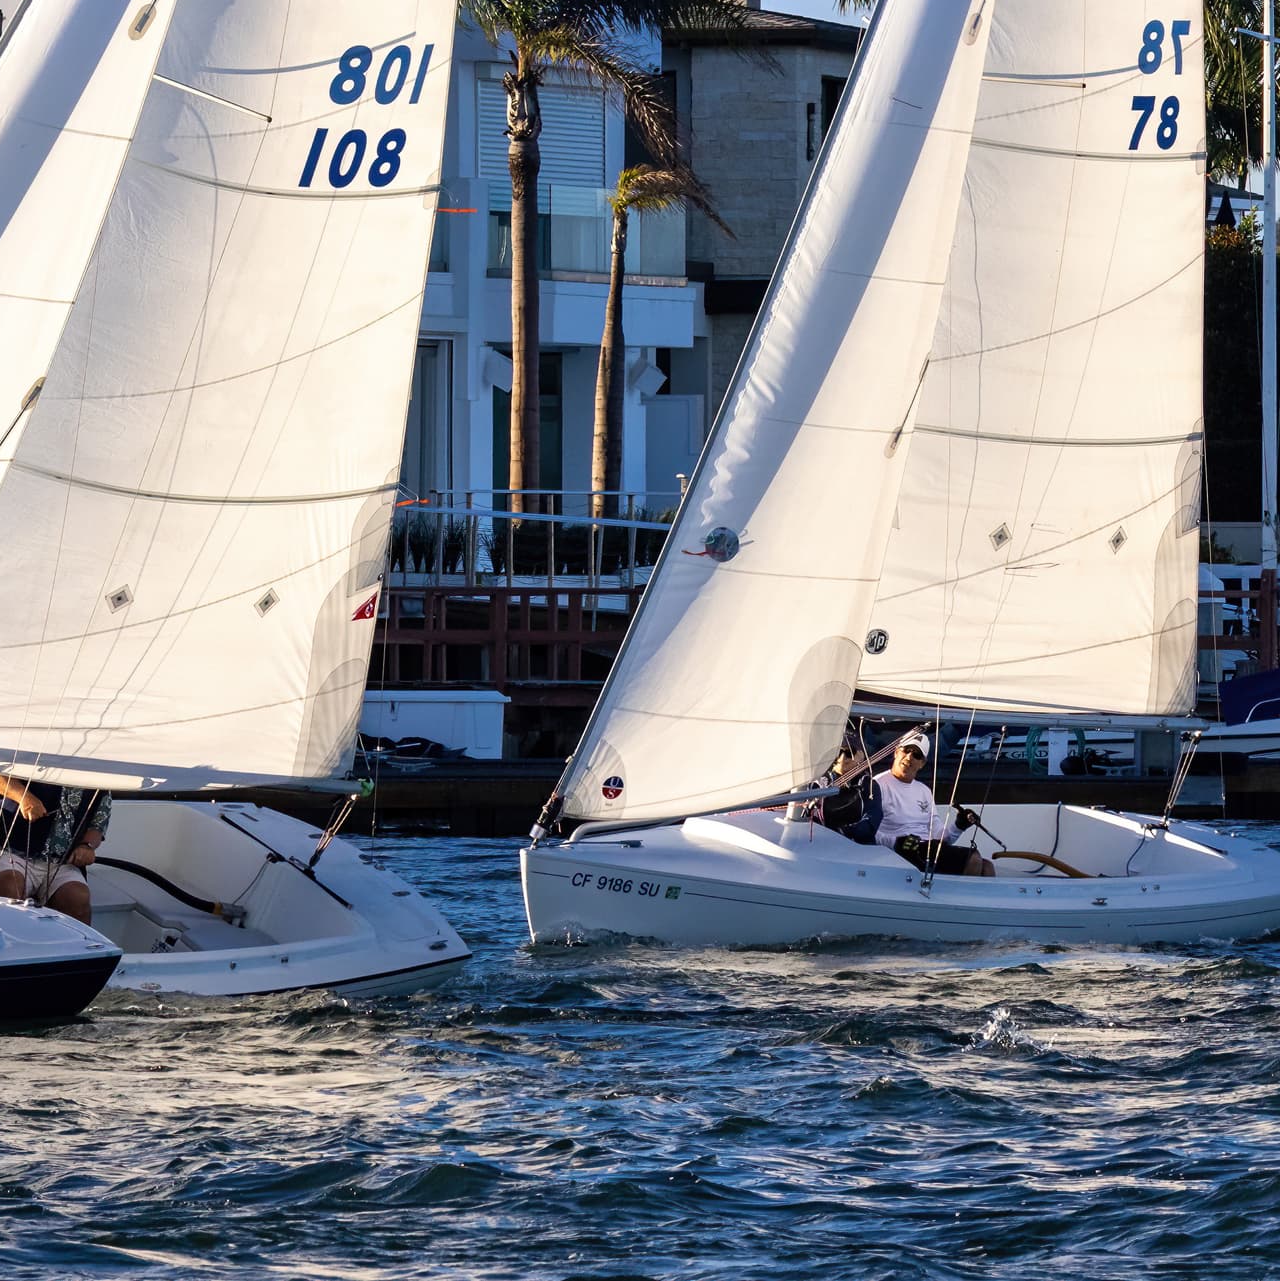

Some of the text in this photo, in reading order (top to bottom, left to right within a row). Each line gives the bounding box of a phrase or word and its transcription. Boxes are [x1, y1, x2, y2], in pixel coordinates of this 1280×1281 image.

[1128, 95, 1180, 150] 78
[298, 128, 407, 189] 108
[572, 872, 593, 887] CF
[597, 876, 633, 893] 9186
[638, 881, 661, 897] SU
